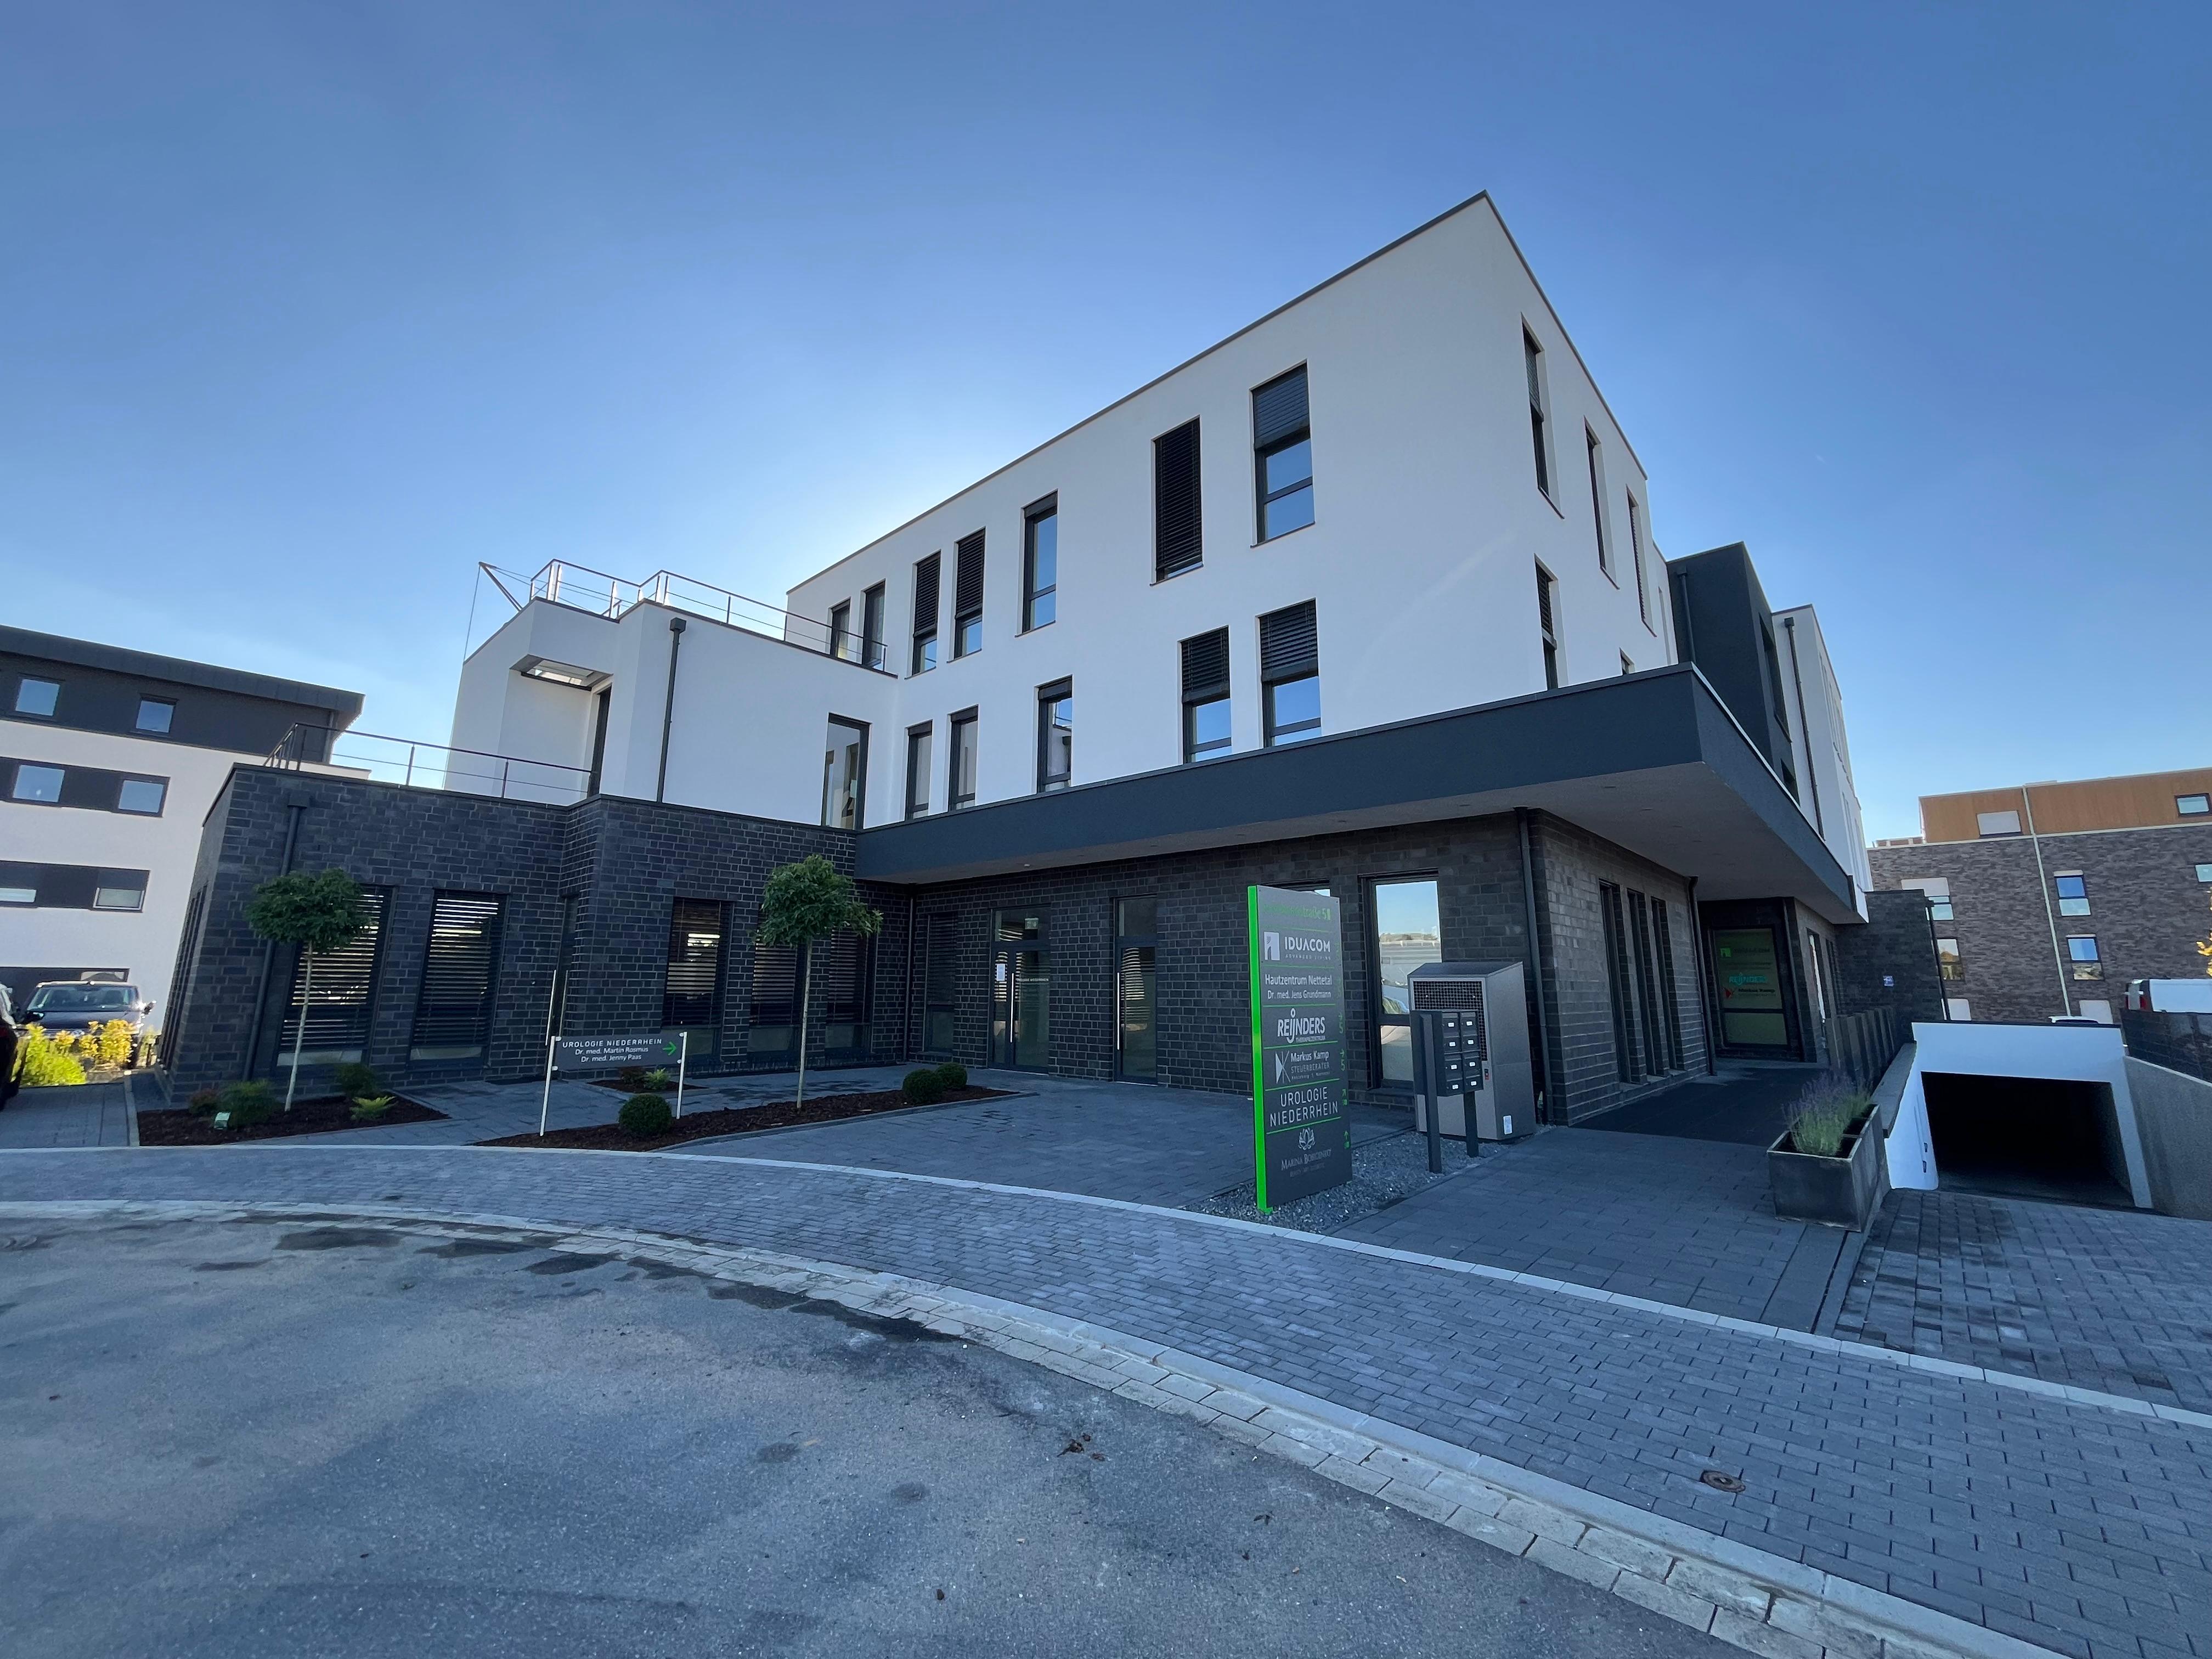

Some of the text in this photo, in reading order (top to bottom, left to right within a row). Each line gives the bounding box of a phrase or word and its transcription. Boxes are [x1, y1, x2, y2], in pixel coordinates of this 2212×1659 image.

[1285, 936, 1330, 952] IDUACOM
[1265, 974, 1333, 985] Hautzentrum Nettetal
[1267, 990, 1276, 999] Dr.
[1277, 990, 1290, 999] med.
[1291, 990, 1302, 998] Jens
[1303, 989, 1331, 998] Grundmann
[1291, 1051, 1329, 1062] Markus Kamp
[1280, 1086, 1328, 1107] UROLOGIE
[1269, 1101, 1339, 1127] NIEDERRHEIN
